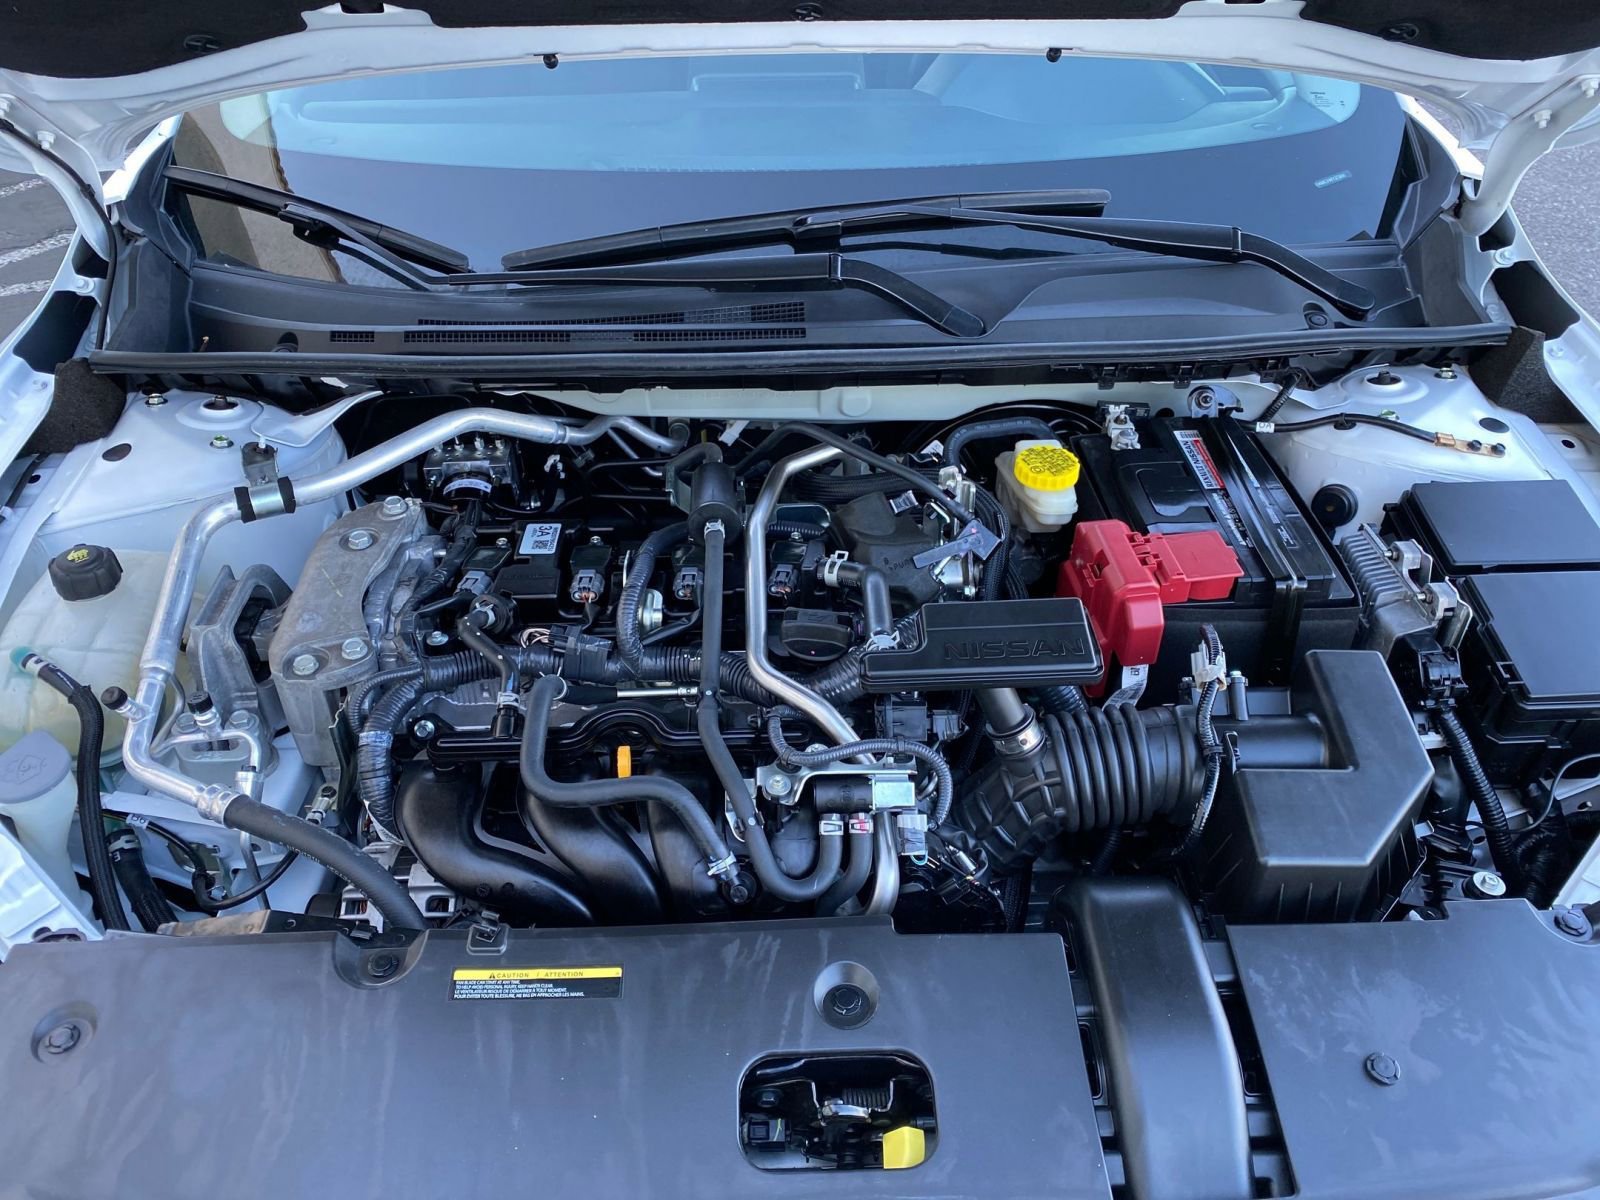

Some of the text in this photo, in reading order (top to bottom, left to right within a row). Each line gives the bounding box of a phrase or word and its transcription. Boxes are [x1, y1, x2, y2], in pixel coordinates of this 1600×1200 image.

[1181, 440, 1200, 464] NISSAN
[536, 525, 552, 537] 3A
[944, 638, 1085, 660] NISSAN
[544, 970, 584, 978] ATTENTION
